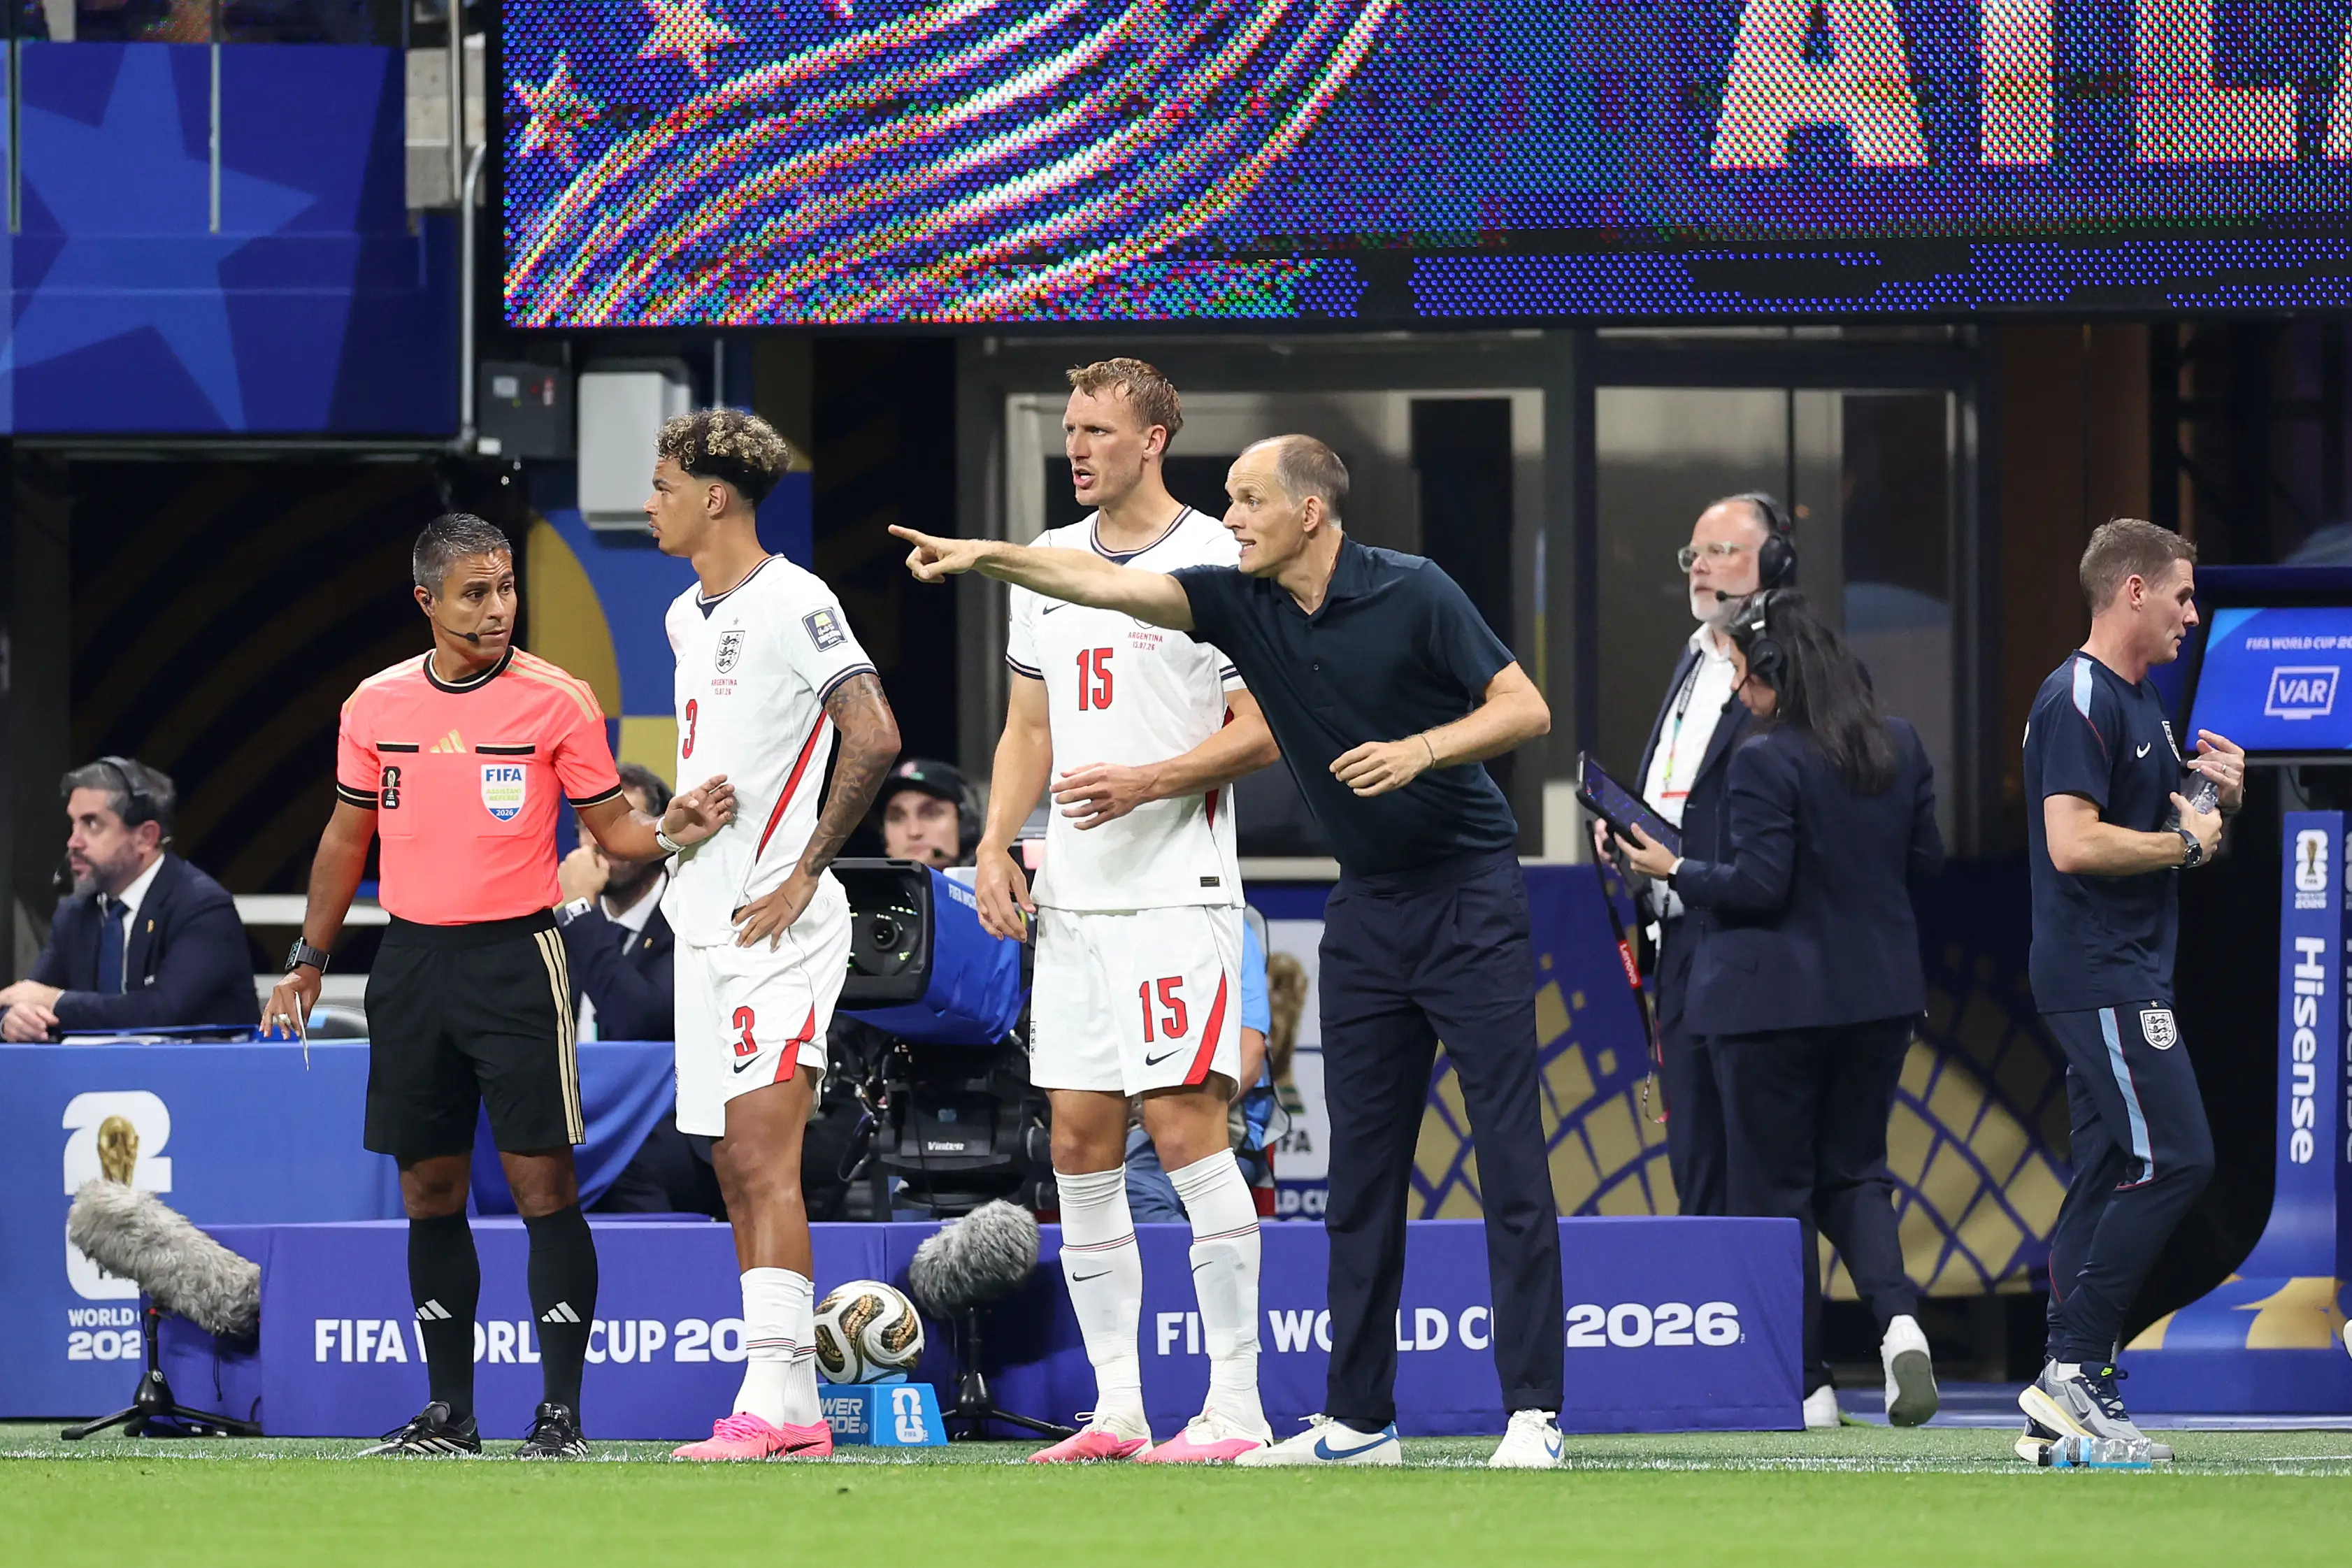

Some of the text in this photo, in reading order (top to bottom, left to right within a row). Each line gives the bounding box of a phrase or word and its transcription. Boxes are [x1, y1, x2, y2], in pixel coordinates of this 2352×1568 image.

[1128, 631, 1163, 642] ARGENTINA
[1133, 641, 1155, 651] 15.07.26
[2246, 637, 2270, 650] FIFA
[2272, 636, 2312, 650] WORLD
[2313, 635, 2337, 650] CUP
[1077, 647, 1113, 711] 15
[2279, 678, 2328, 704] VAR
[682, 698, 698, 759] 3
[486, 768, 522, 782] FIFA
[1619, 944, 1637, 984] Lenovo
[1139, 976, 1189, 1042] 15
[732, 1005, 758, 1057] 3
[2290, 936, 2325, 1164] Hisense
[68, 1307, 135, 1327] WORLD
[1268, 1307, 1449, 1353] WOLD
[1565, 1301, 1741, 1348] 2026
[68, 1330, 141, 1360] 202
[315, 1318, 408, 1363] FIFA
[585, 1318, 667, 1364] CUP
[673, 1317, 749, 1363] 20
[820, 1397, 863, 1416] WER
